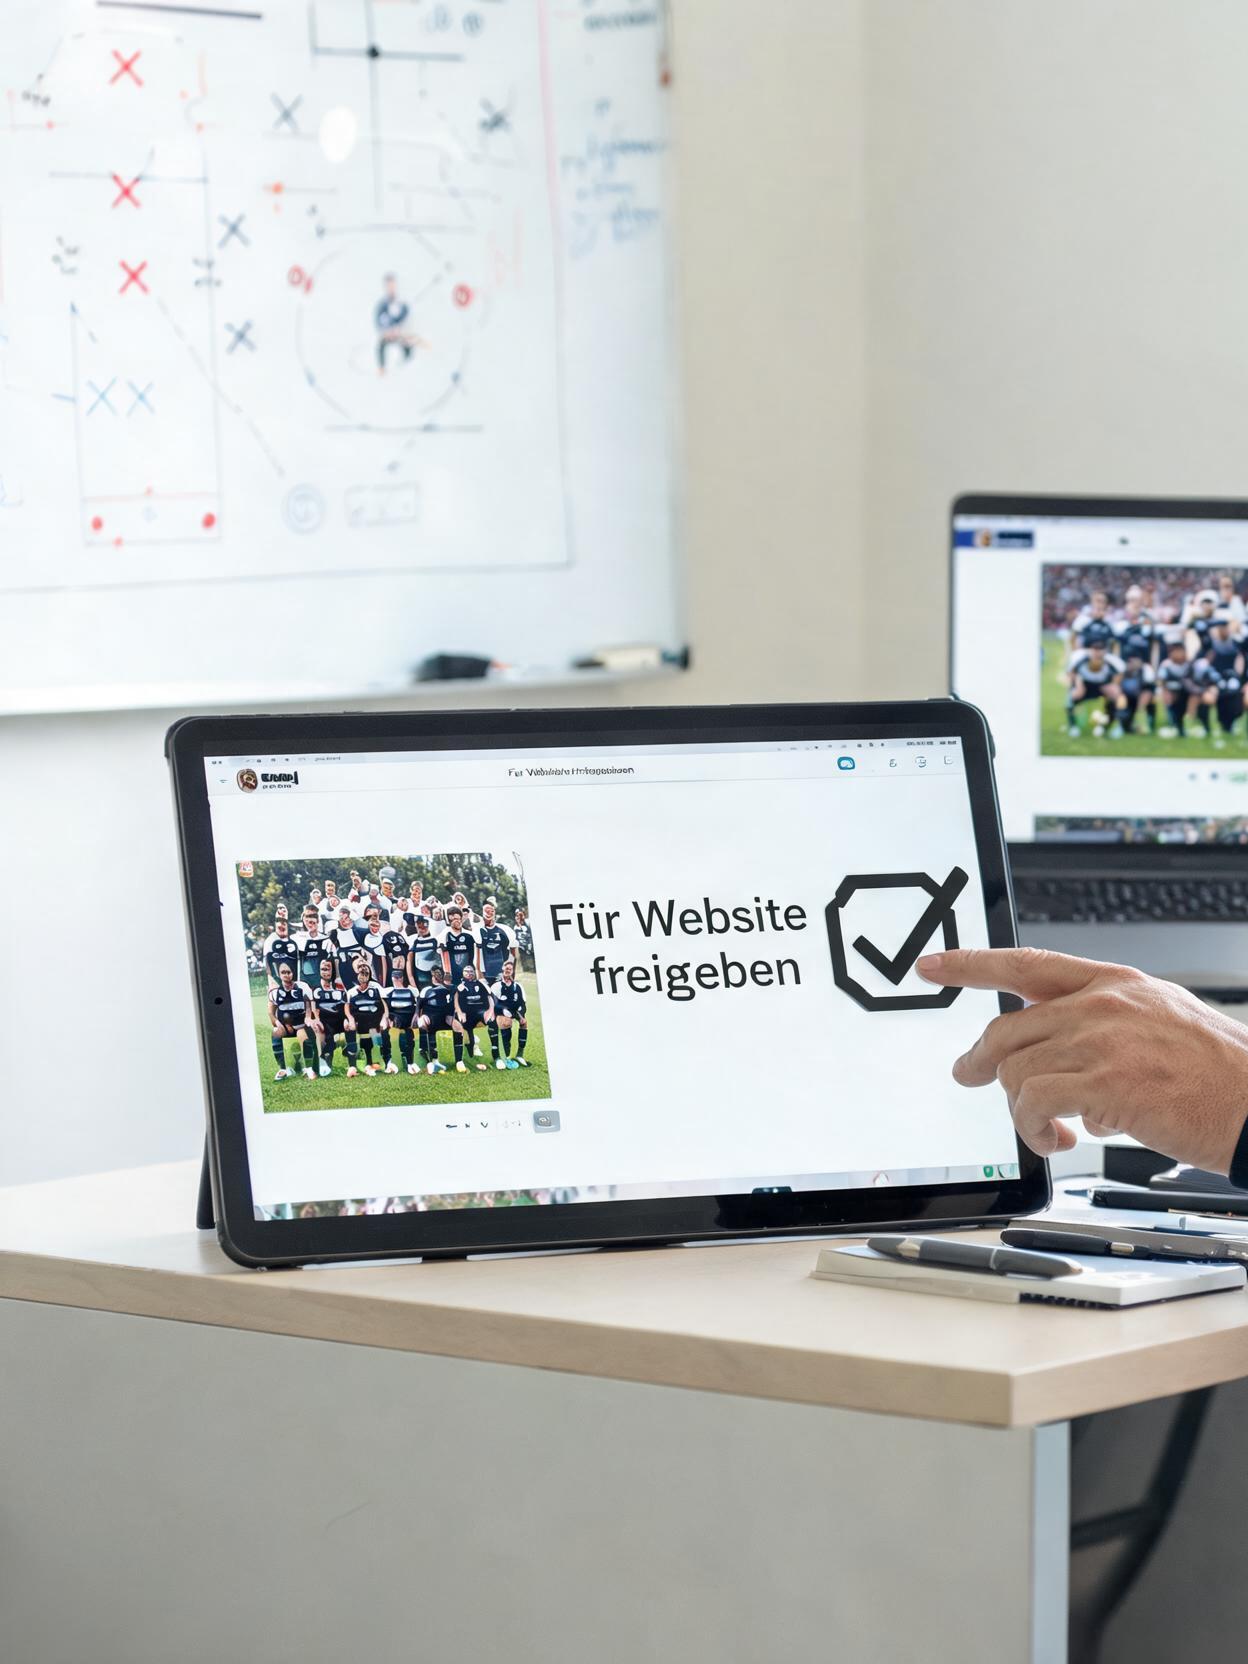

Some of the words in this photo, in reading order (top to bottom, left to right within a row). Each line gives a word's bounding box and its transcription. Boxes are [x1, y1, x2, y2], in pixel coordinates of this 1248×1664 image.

[549, 902, 620, 941] Für
[631, 896, 807, 938] Website
[589, 951, 801, 1001] freigeben
